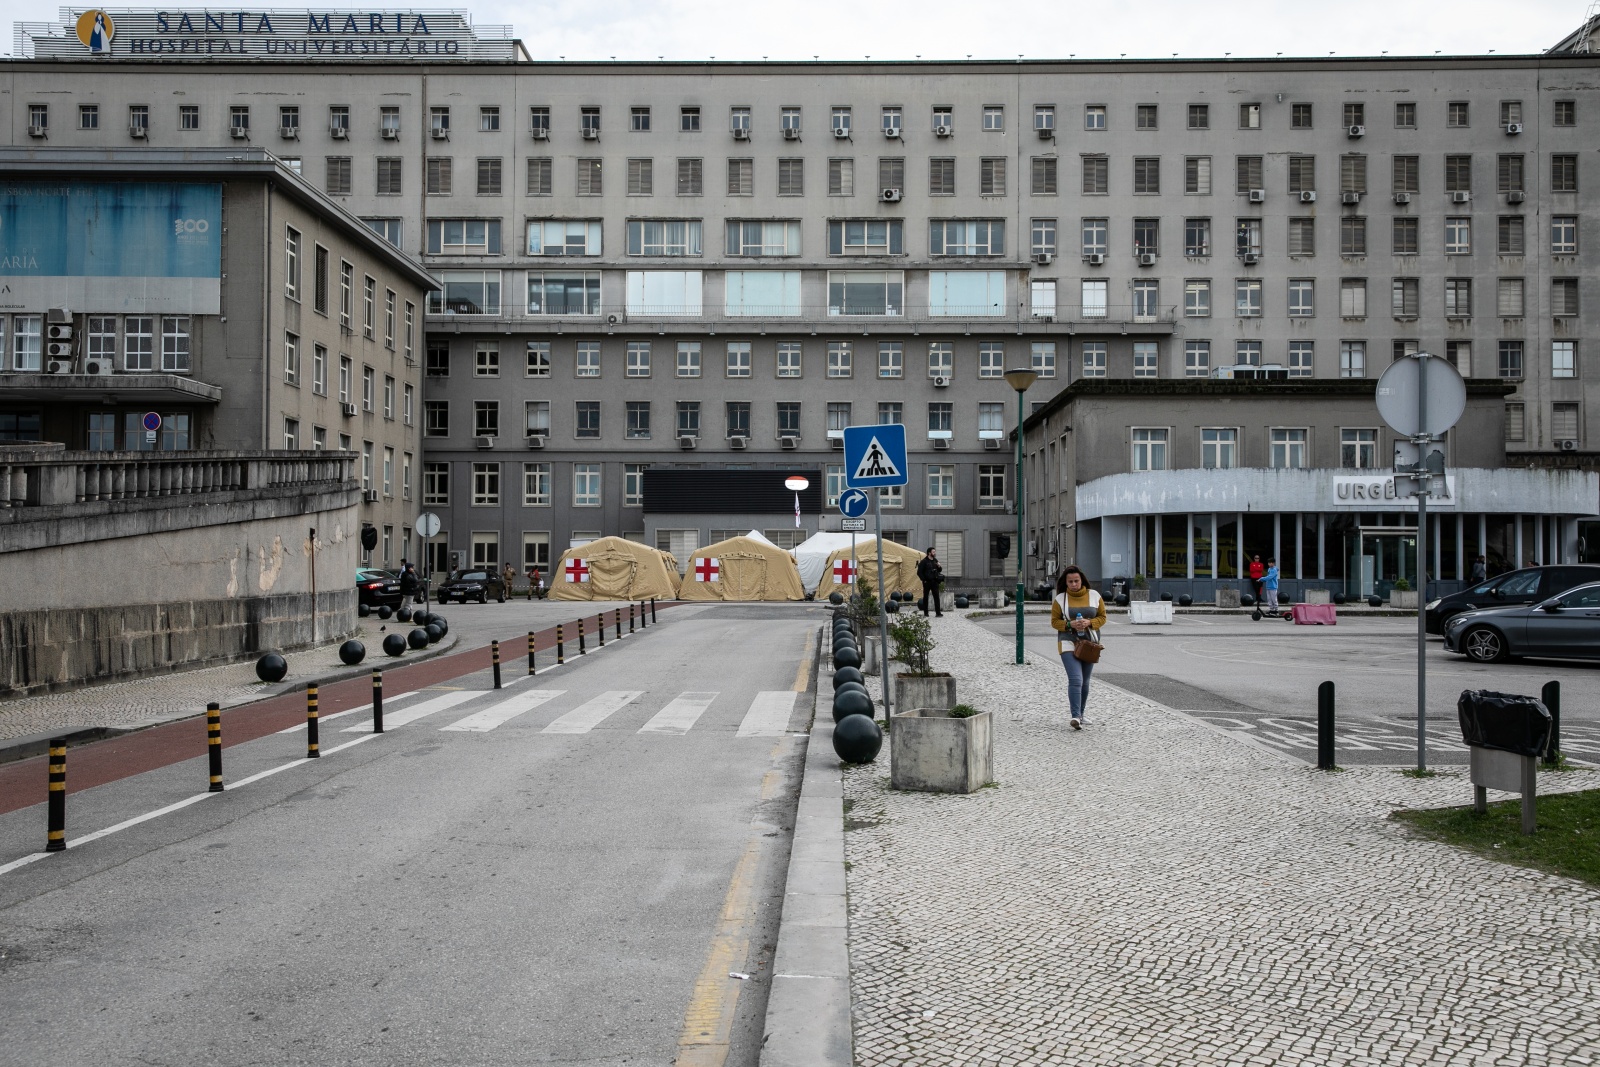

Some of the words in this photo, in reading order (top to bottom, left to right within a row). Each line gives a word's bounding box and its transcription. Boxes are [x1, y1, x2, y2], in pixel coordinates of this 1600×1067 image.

[157, 12, 275, 34] SANTA
[306, 13, 431, 35] MARIA
[130, 39, 248, 54] HOSPITAL
[265, 37, 459, 54] UNIVERSITÁRIO
[0, 187, 33, 196] ISBOA
[1337, 479, 1452, 500] URGÊ
